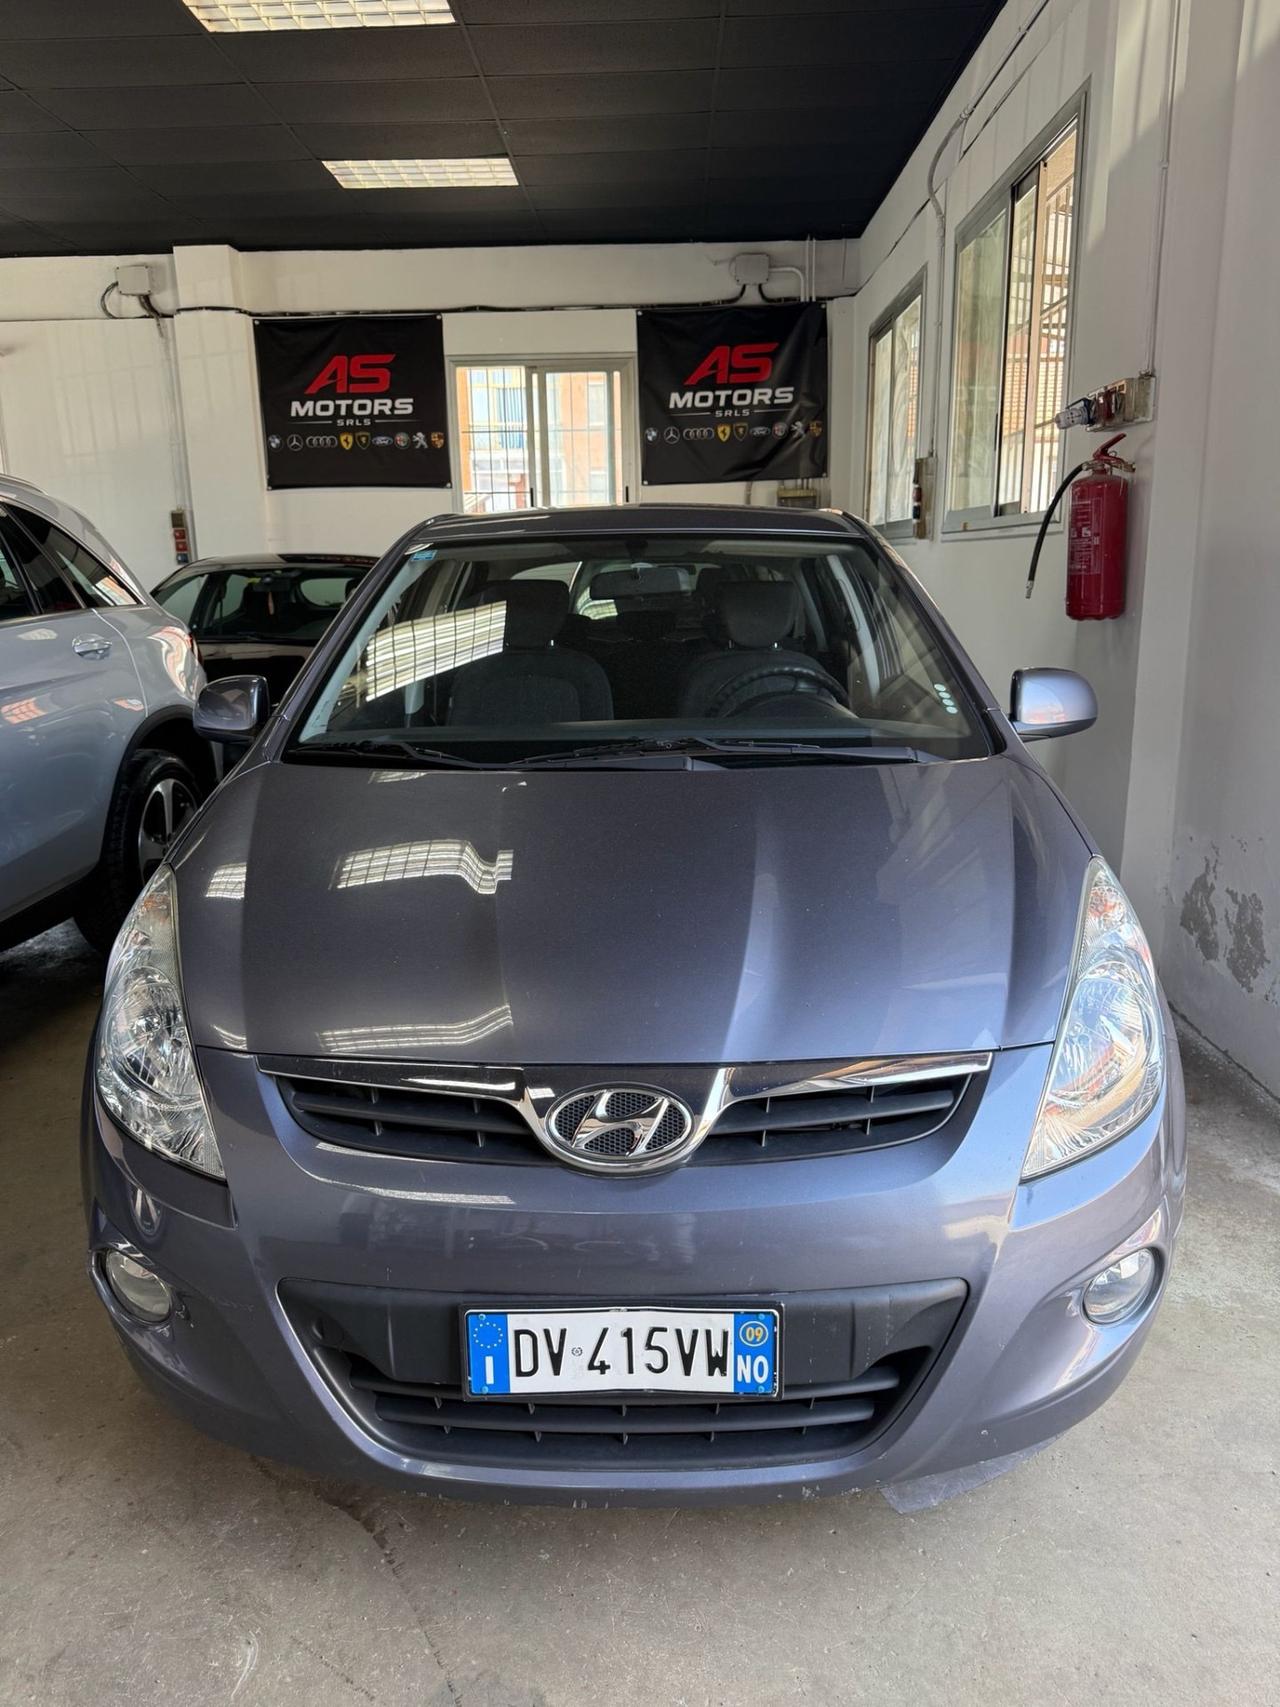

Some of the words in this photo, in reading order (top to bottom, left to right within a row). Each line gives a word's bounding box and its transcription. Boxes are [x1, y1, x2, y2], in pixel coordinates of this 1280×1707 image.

[303, 353, 396, 395] AS
[683, 342, 779, 386] AS
[290, 398, 414, 417] MOTORS
[668, 387, 795, 409] MOTORS
[336, 418, 371, 427] SRLS
[715, 409, 750, 418] SRLS
[746, 1327, 763, 1342] 09
[514, 1327, 567, 1377] DV
[587, 1326, 729, 1377] 415VW
[737, 1355, 769, 1384] NO
